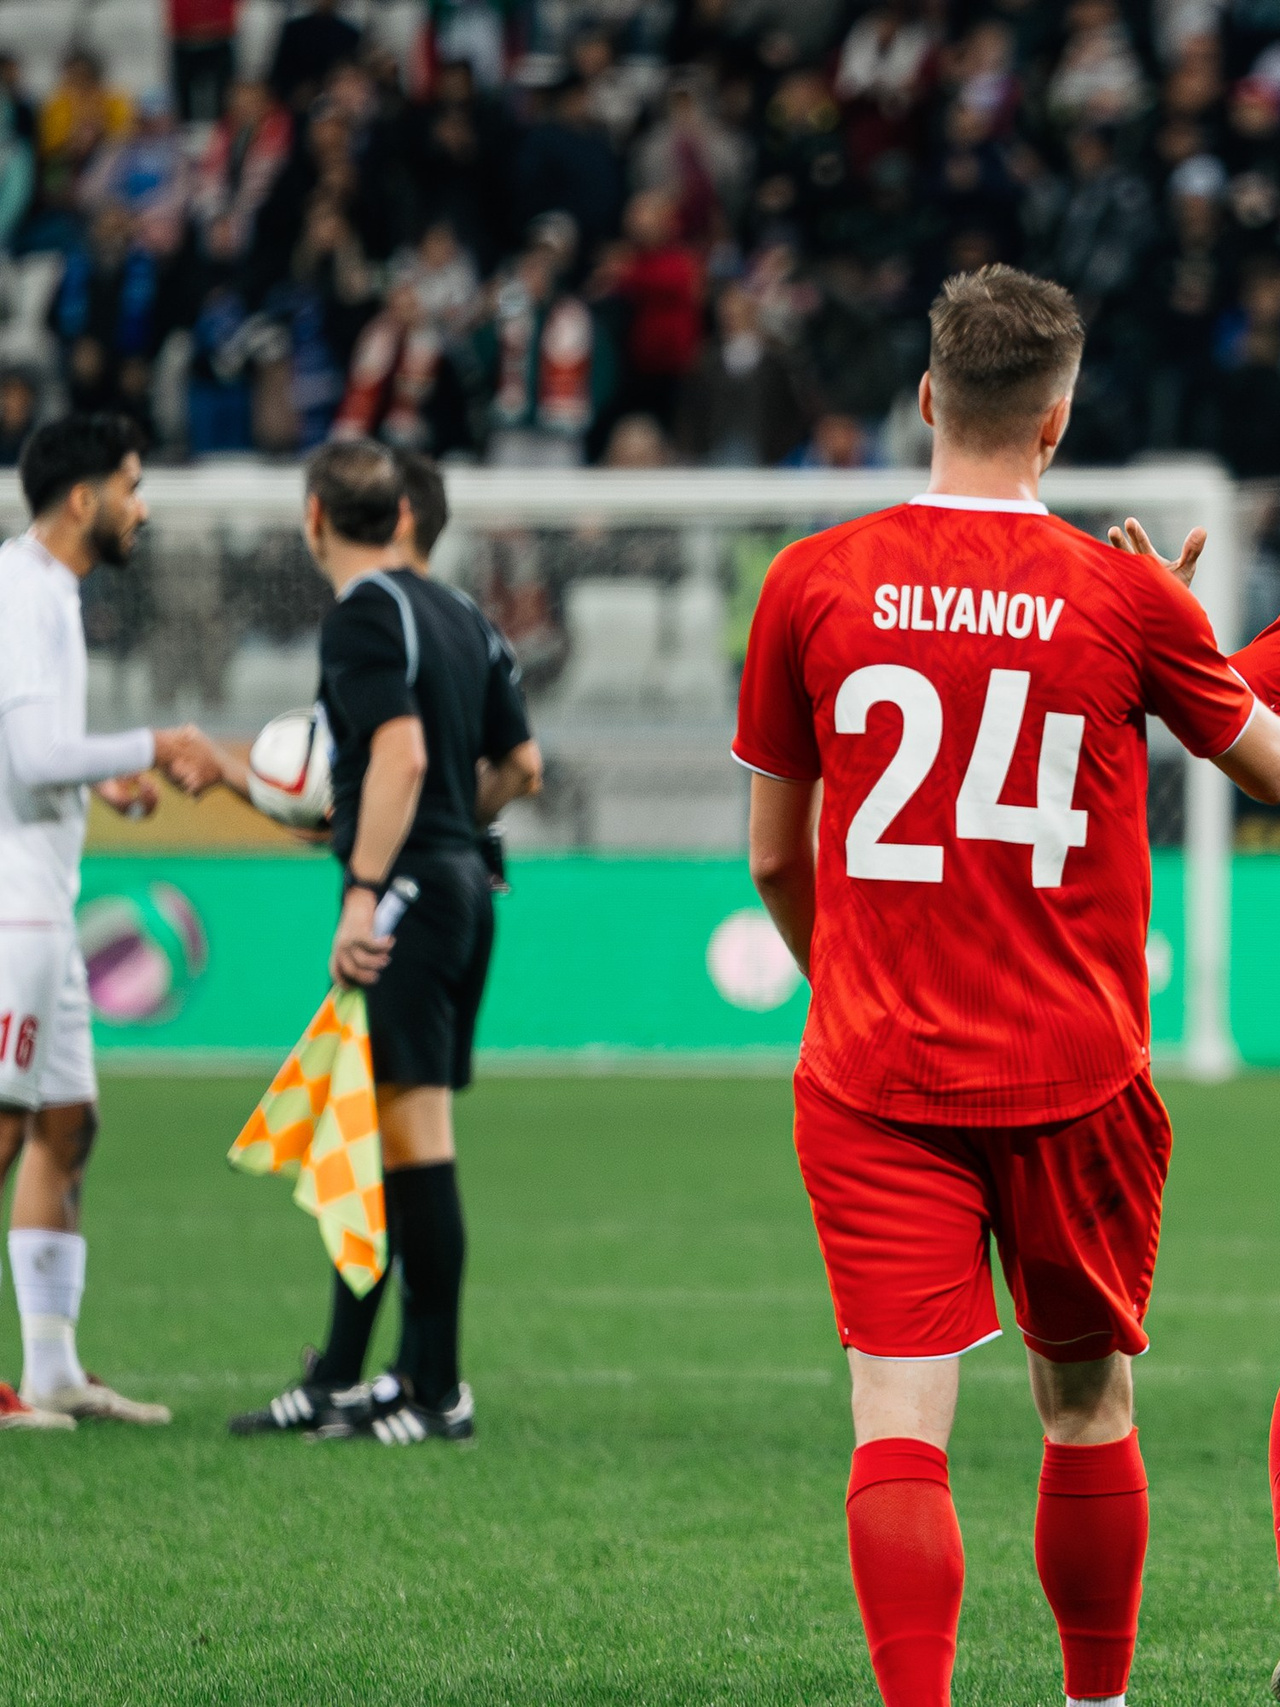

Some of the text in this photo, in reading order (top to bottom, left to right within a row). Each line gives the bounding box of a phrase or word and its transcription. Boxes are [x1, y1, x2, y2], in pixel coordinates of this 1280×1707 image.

[873, 584, 1065, 641] SILYANOV
[834, 663, 1088, 888] 24
[0, 1011, 39, 1073] 16
